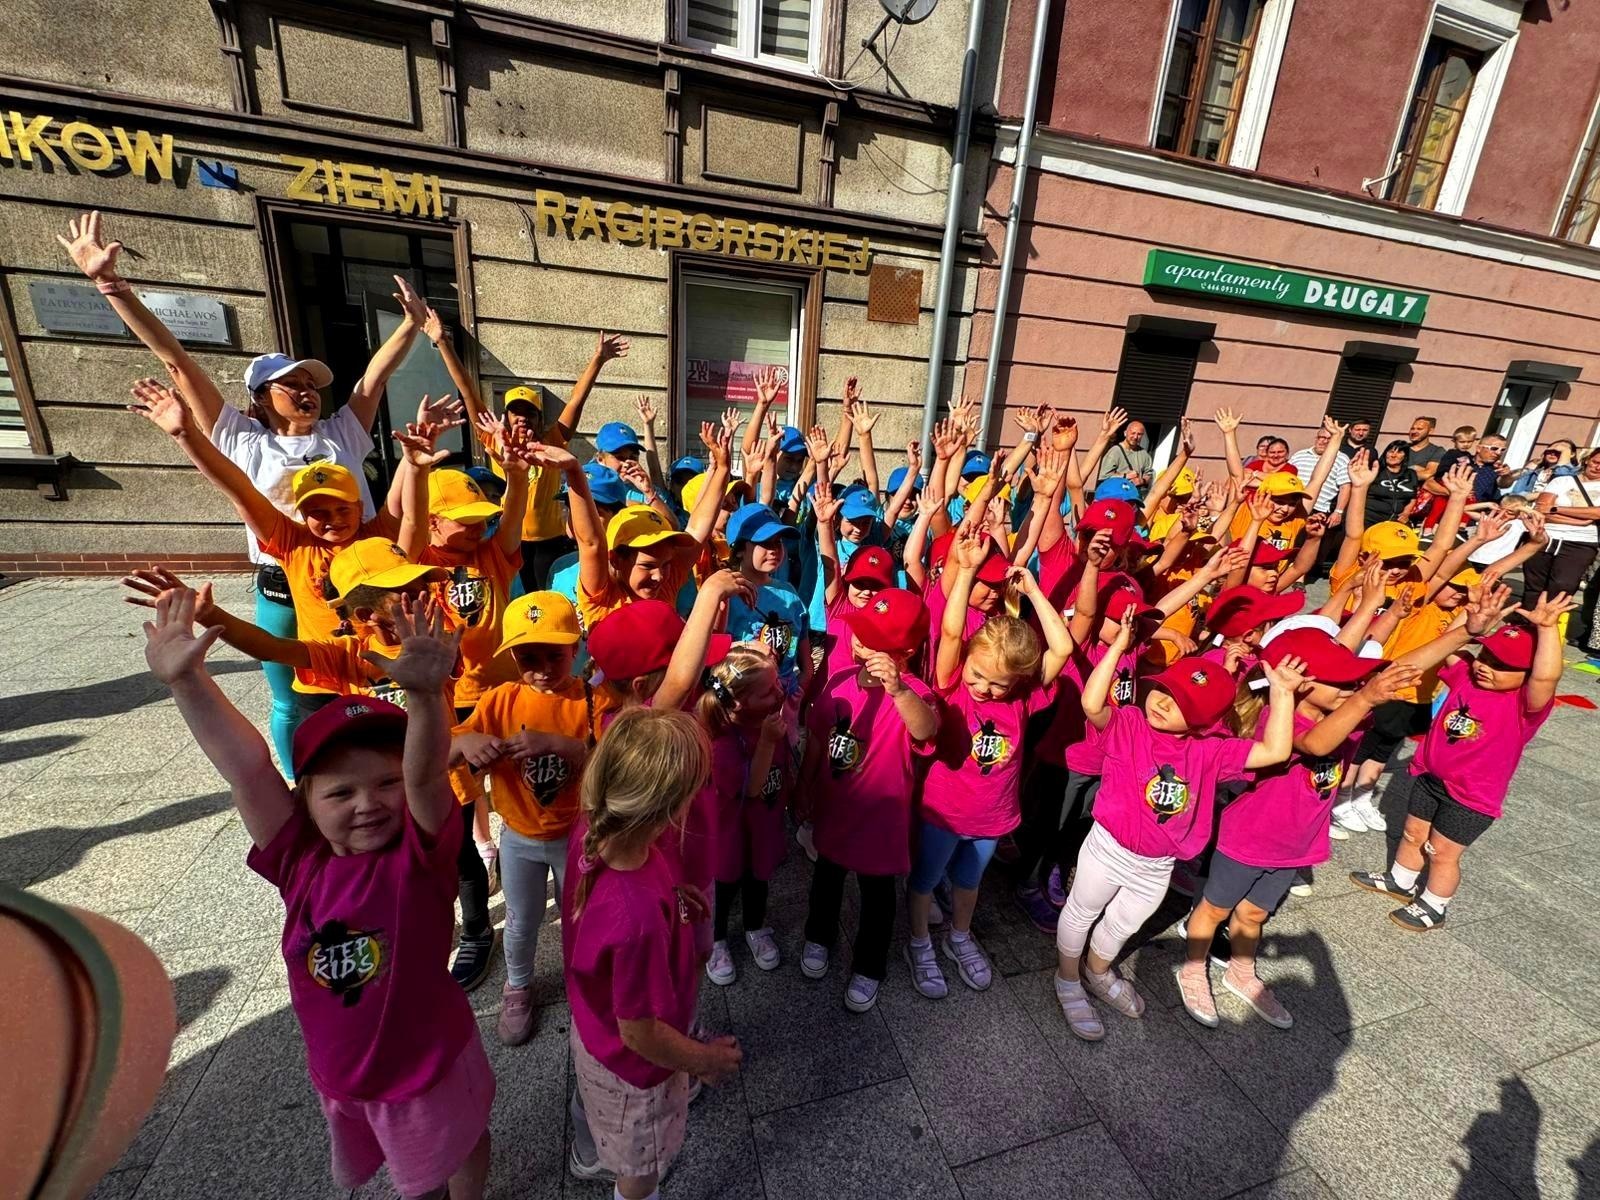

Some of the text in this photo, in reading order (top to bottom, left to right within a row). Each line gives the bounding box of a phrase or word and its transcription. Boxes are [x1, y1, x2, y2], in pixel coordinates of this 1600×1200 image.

[280, 153, 443, 218] ZIEMI
[1165, 263, 1419, 318] apartamenty DŁUGA 7
[448, 580, 481, 596] STEP
[448, 591, 485, 607] KIDS
[1114, 680, 1132, 691] STE
[376, 689, 404, 704] TEP
[1113, 689, 1131, 701] KID
[975, 735, 1003, 747] STEP
[830, 744, 853, 764] IDS
[973, 744, 1002, 758] KIDS
[523, 767, 567, 783] KIDS
[1151, 781, 1185, 796] STEP
[1149, 791, 1184, 808] KIDS
[312, 936, 369, 964] STEP
[313, 953, 374, 980] KIDS
